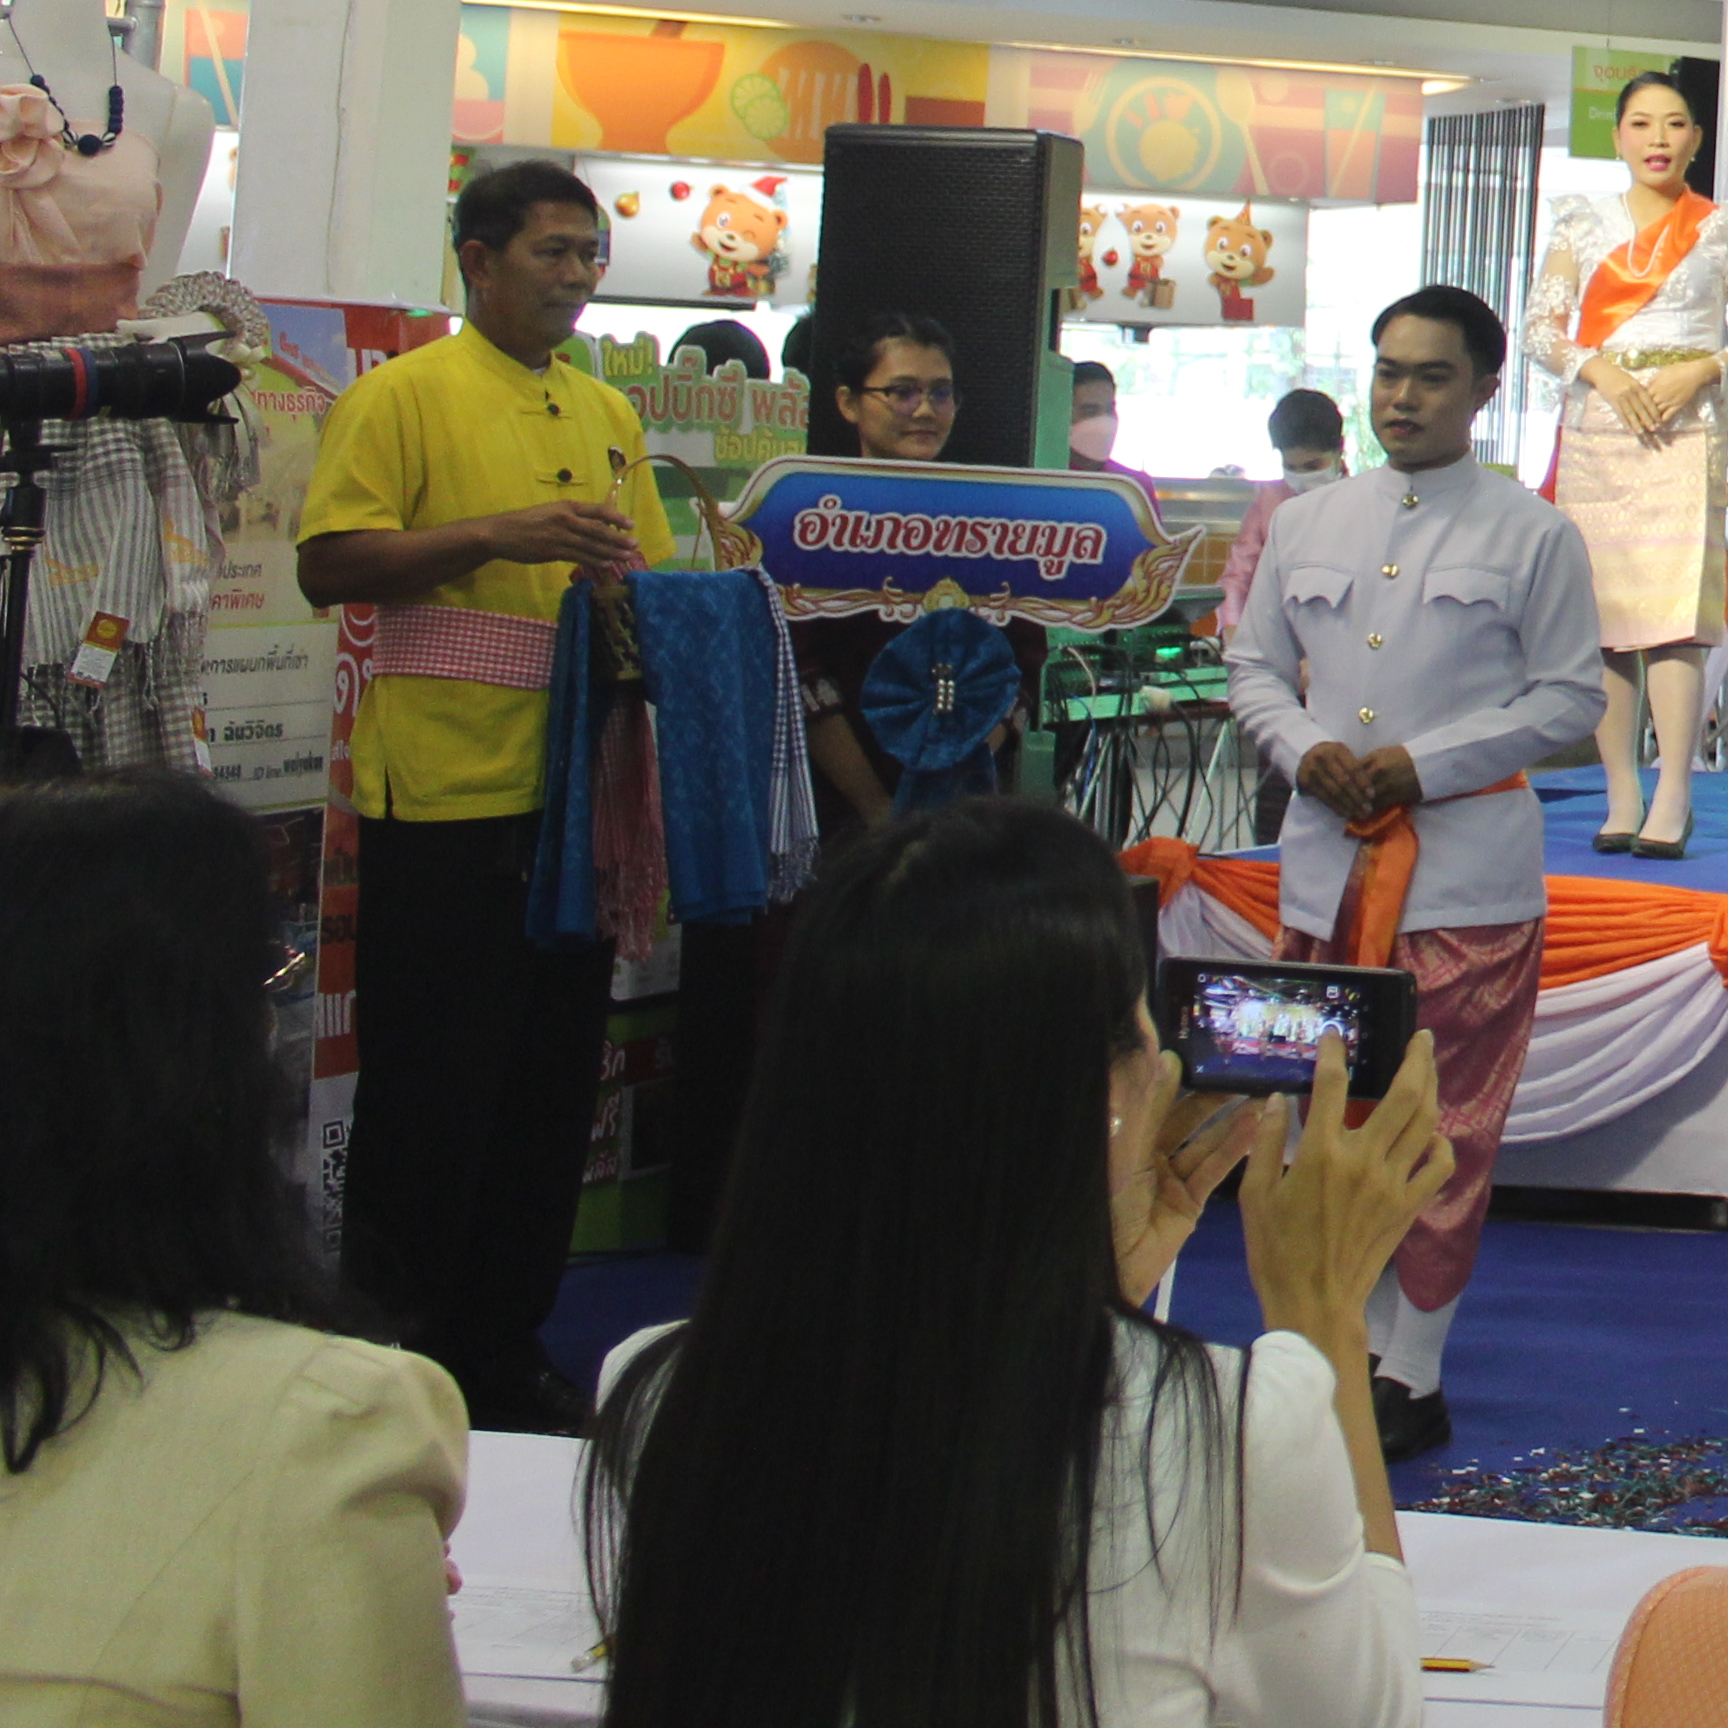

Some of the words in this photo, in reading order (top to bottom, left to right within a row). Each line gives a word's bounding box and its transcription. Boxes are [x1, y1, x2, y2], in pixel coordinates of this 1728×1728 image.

[797, 495, 1104, 578] อำเภอทรายมูล
